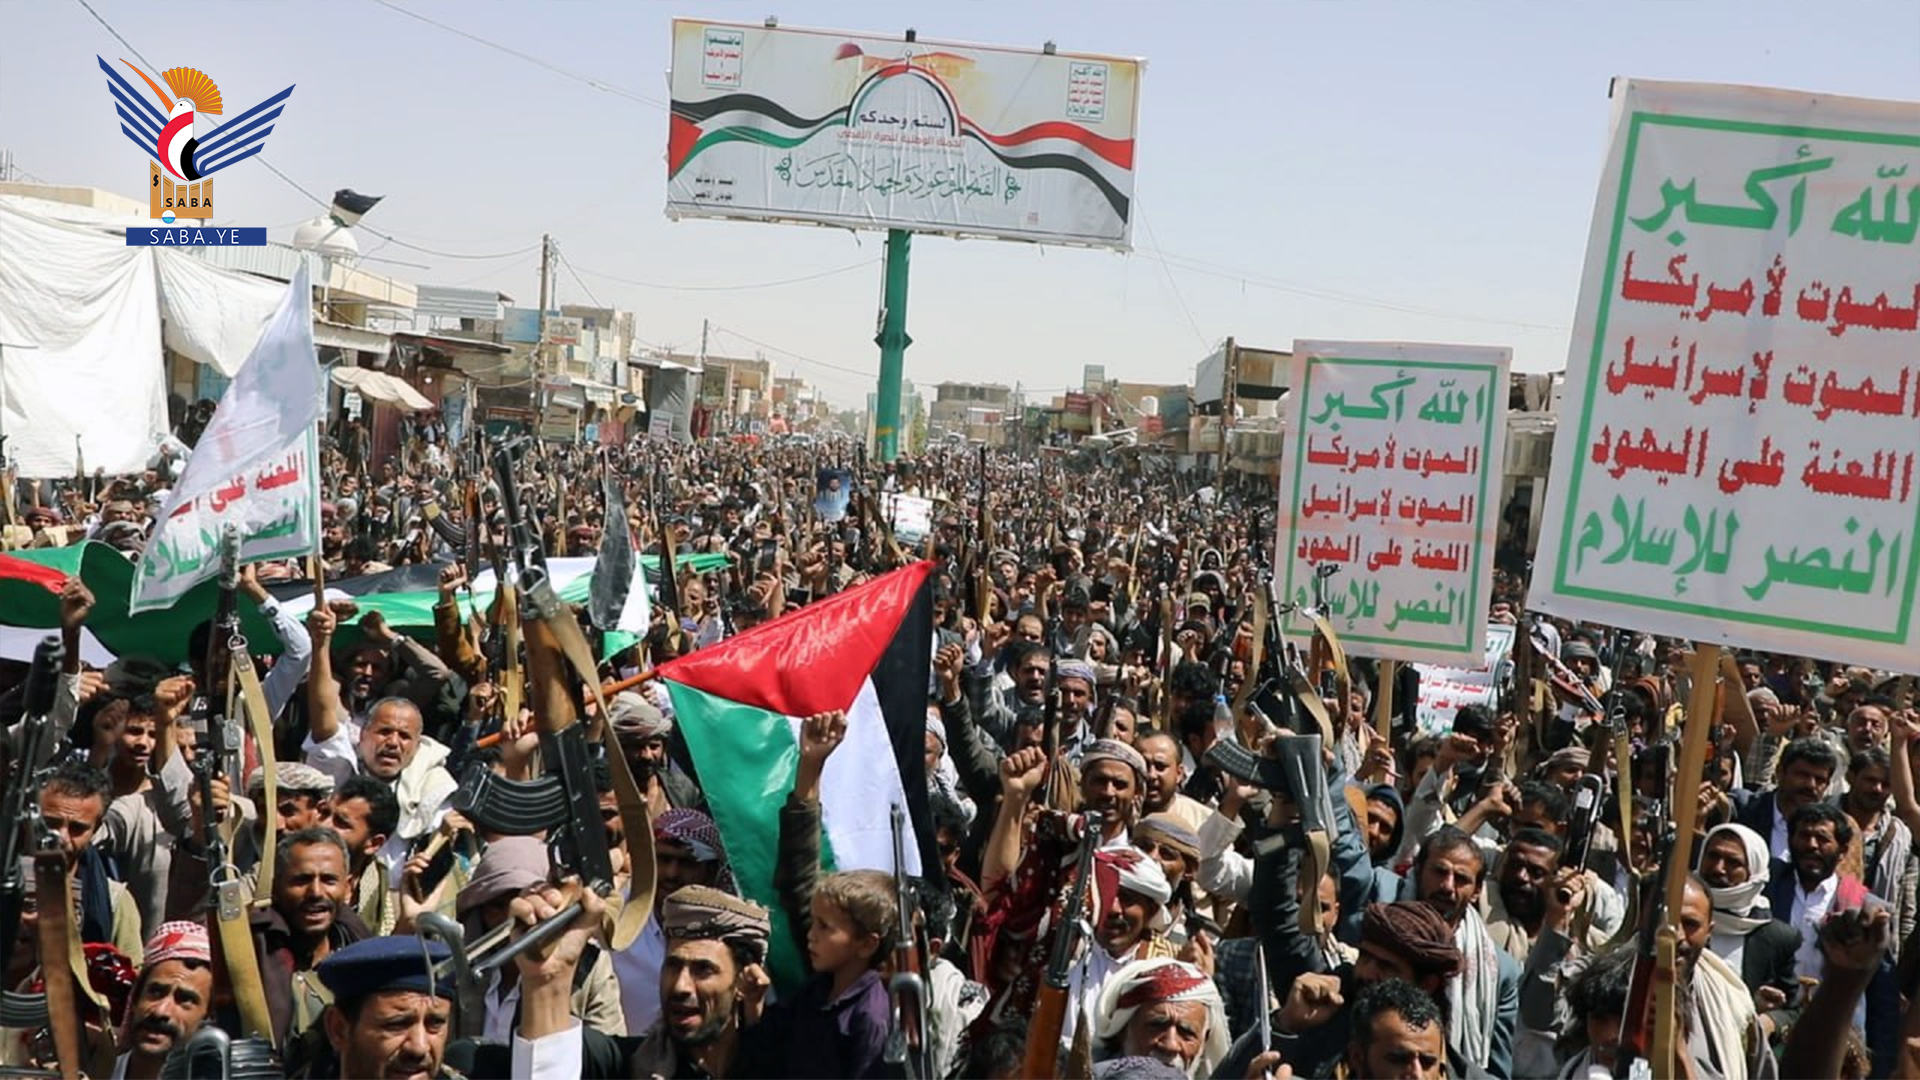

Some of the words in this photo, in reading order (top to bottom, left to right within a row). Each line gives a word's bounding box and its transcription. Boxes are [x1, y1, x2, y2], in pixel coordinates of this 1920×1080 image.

[858, 110, 907, 130] وحدكم
[911, 114, 947, 129] لستم
[1628, 143, 1835, 247] أكبر
[1831, 164, 1920, 247] لله
[1621, 251, 1787, 321] لأمريكا
[1796, 279, 1920, 336] لموت
[1606, 334, 1776, 414] لإسرائيل
[1308, 369, 1417, 432] أكبر
[1417, 378, 1485, 425] الله
[1307, 432, 1397, 474] لأمريكا
[1403, 445, 1478, 478] الموت
[1591, 423, 1710, 486] اليهود
[1717, 435, 1786, 494] على
[1800, 440, 1914, 504] اللعنة
[210, 474, 246, 513] على
[1302, 482, 1392, 525] لإسرائيل
[1398, 494, 1474, 527] الموت
[1297, 534, 1360, 567] اليهود
[1367, 538, 1402, 572] على
[1412, 538, 1468, 572] اللعنة
[1574, 493, 1740, 598] للإسلام
[1743, 516, 1903, 601] النصر
[1384, 581, 1466, 631] النصر
